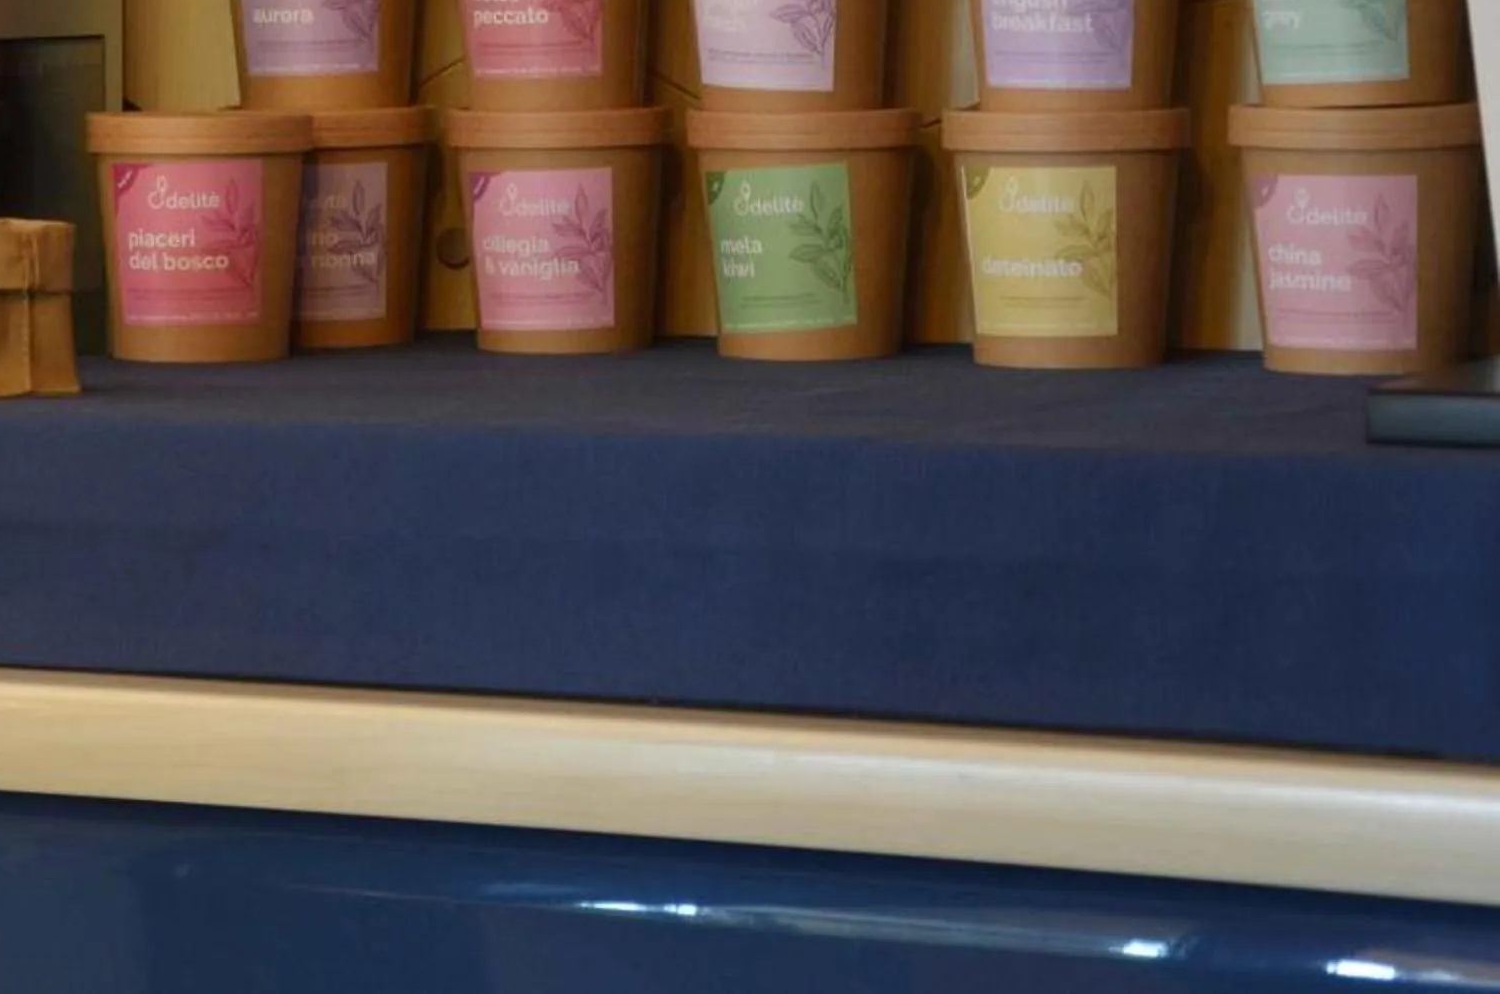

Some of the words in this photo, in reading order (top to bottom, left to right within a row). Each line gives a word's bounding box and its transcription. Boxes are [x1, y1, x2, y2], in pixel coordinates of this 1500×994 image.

[253, 5, 314, 25] aurora
[472, 7, 549, 28] peccato
[128, 227, 196, 251] piaceri
[720, 236, 763, 255] mela
[129, 252, 157, 271] del
[163, 252, 229, 271] bosco
[1267, 241, 1322, 266] china
[500, 257, 581, 283] vaniglia
